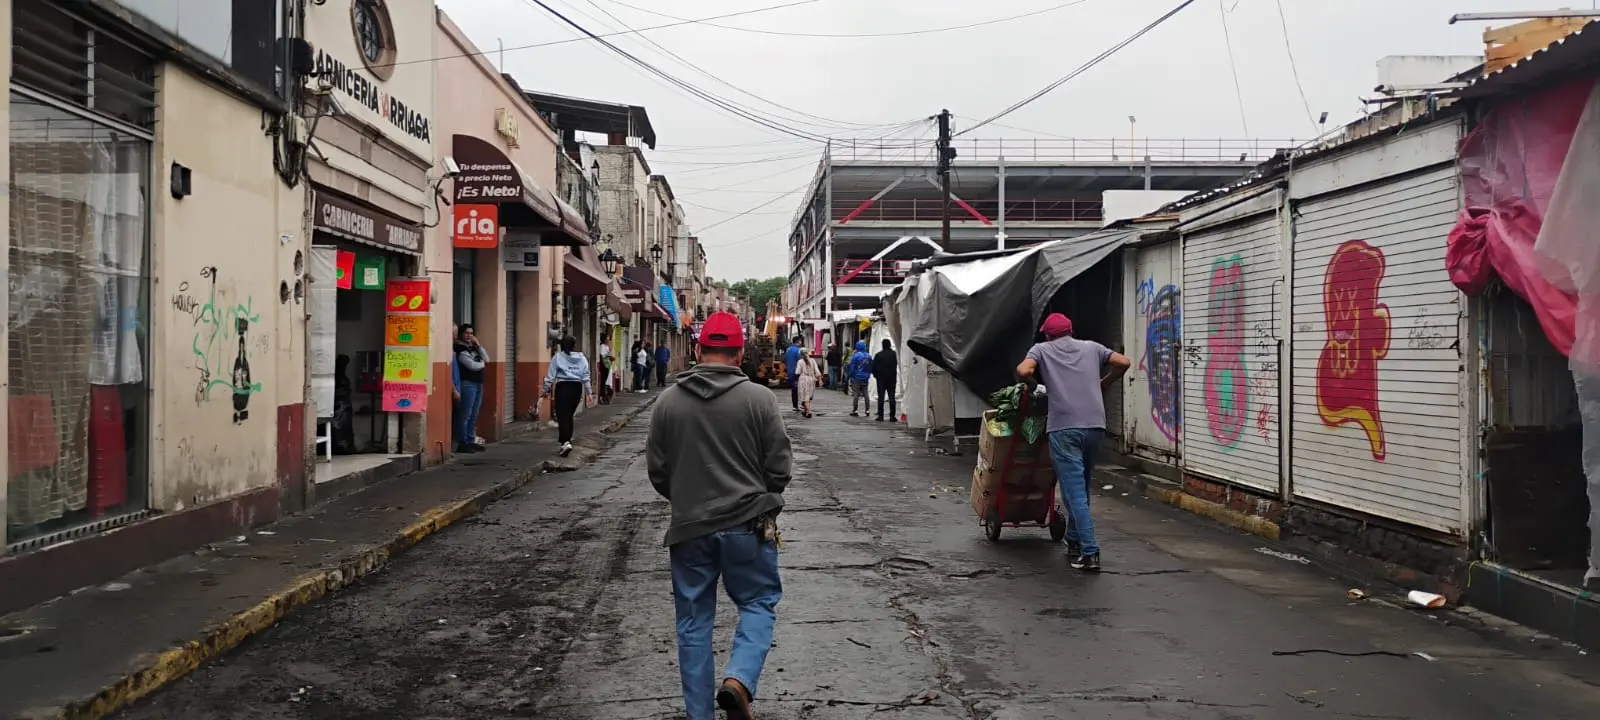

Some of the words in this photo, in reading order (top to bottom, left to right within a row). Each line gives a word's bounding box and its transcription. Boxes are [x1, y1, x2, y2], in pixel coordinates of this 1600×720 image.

[313, 48, 379, 115] ARNICERIA
[459, 163, 470, 171] Tu
[470, 163, 511, 172] despensa
[464, 174, 490, 183] precio
[457, 186, 478, 199] ¡Es
[482, 186, 521, 197] Neto!
[322, 203, 374, 239] CARNICERIA
[457, 209, 495, 235] ria
